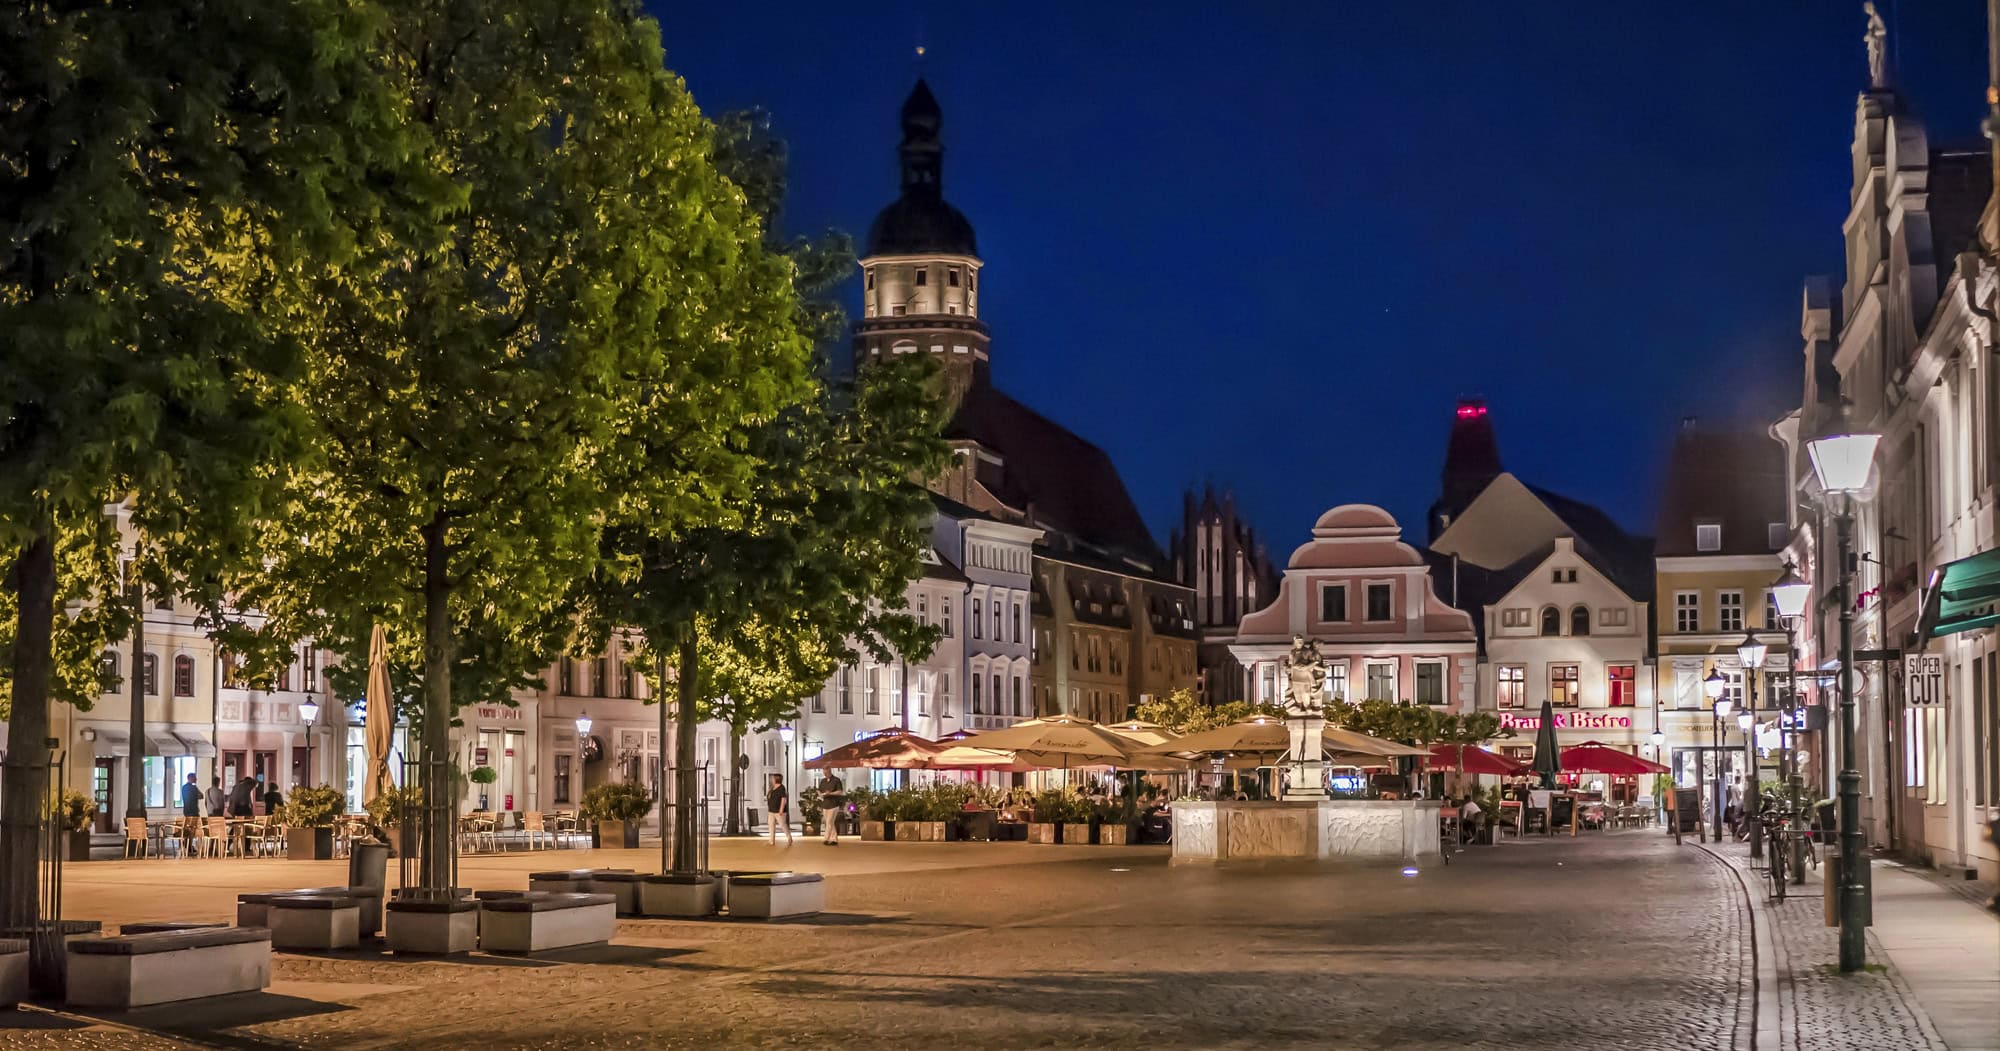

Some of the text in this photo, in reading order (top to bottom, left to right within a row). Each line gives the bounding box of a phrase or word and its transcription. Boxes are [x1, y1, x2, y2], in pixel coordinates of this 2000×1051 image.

[1909, 657, 1940, 674] SUPER
[1910, 674, 1941, 704] CUT
[1553, 713, 1567, 729] &
[1570, 711, 1632, 729] Bistro
